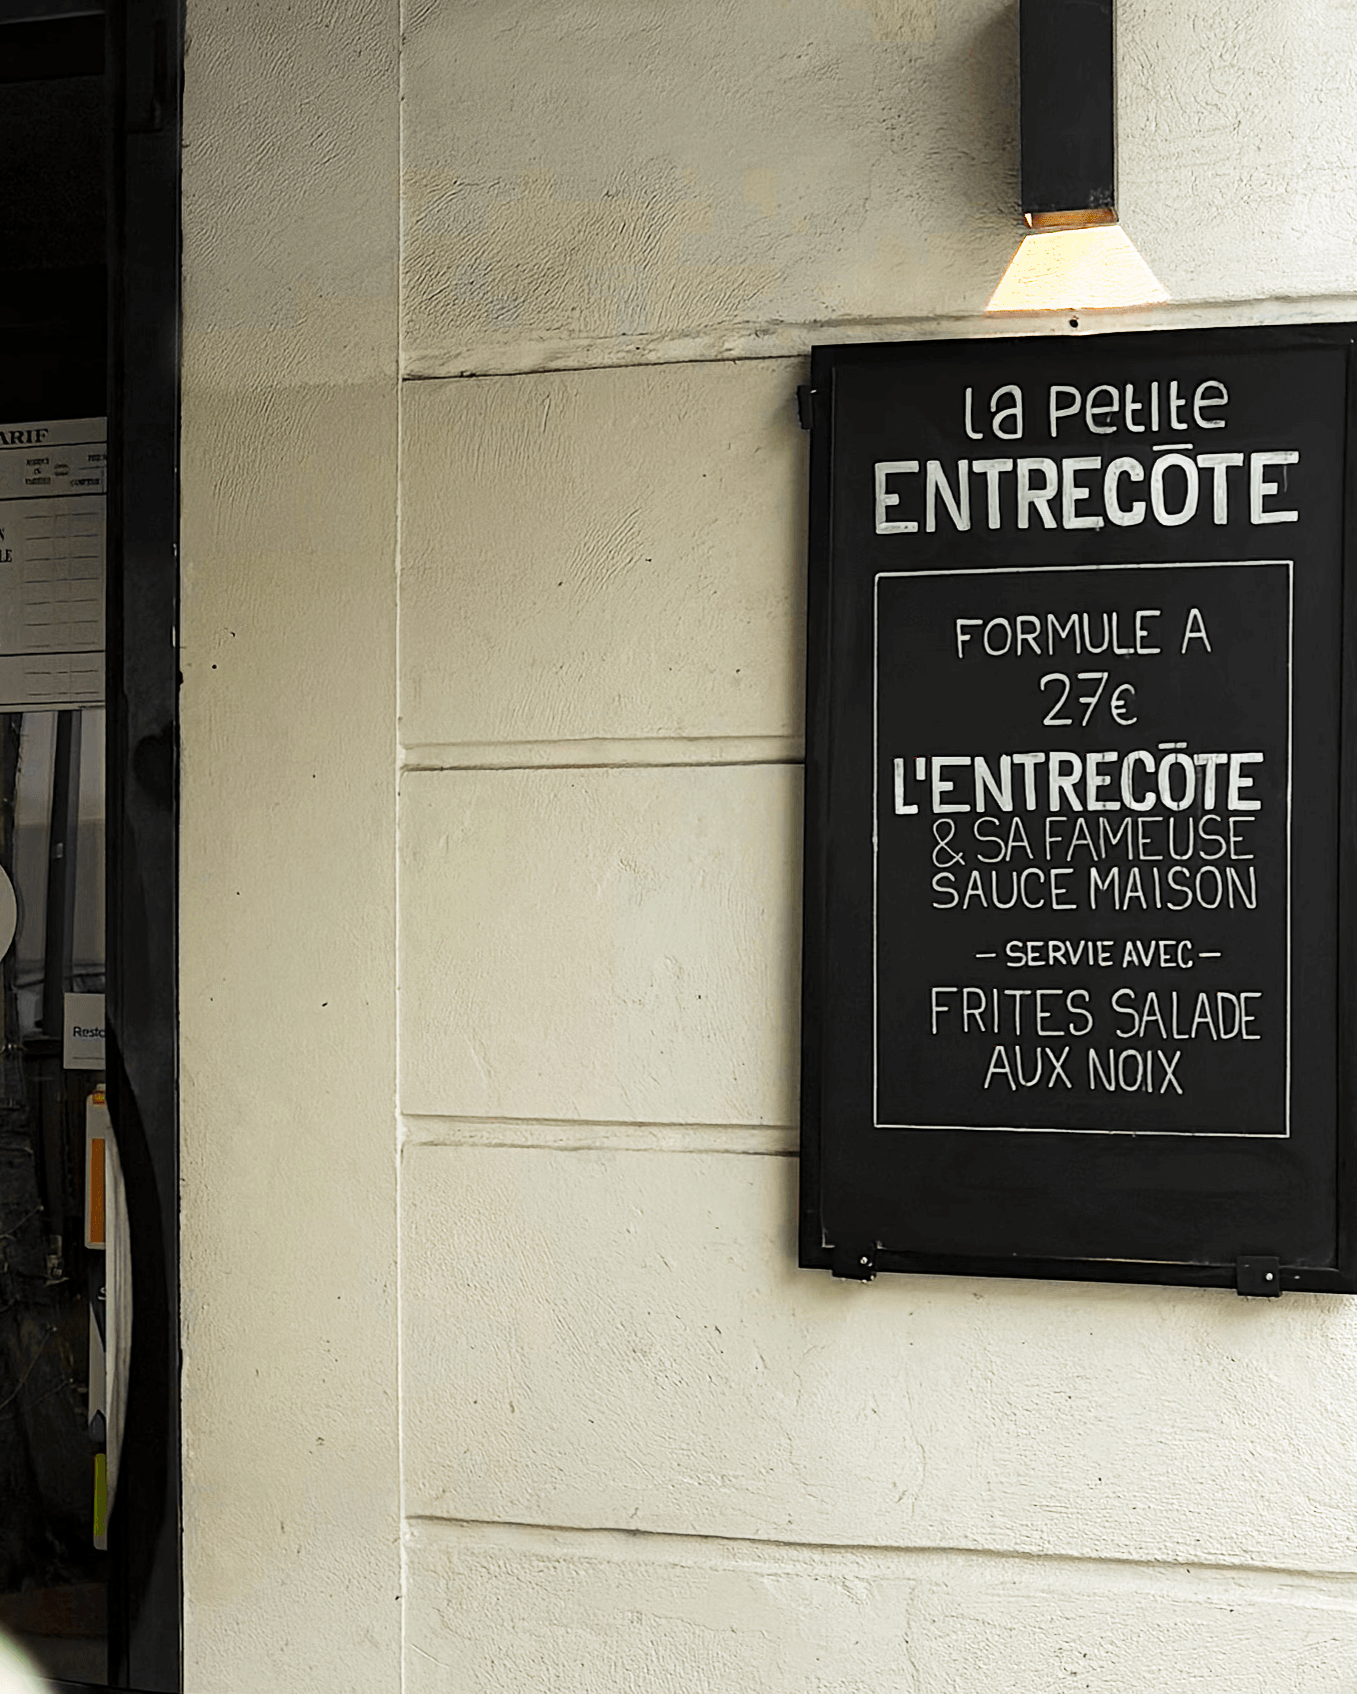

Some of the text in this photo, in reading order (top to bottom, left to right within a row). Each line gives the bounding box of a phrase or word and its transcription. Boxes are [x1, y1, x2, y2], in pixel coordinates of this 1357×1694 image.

[956, 608, 1212, 659] FORMULE A
[1040, 672, 1138, 727] 27€
[931, 814, 1256, 868] & SA FAMEUSE
[931, 866, 1258, 911] SAUCE MAISON
[931, 987, 1263, 1041] FRITES SALADE
[984, 1044, 1184, 1096] AUX NOIX
